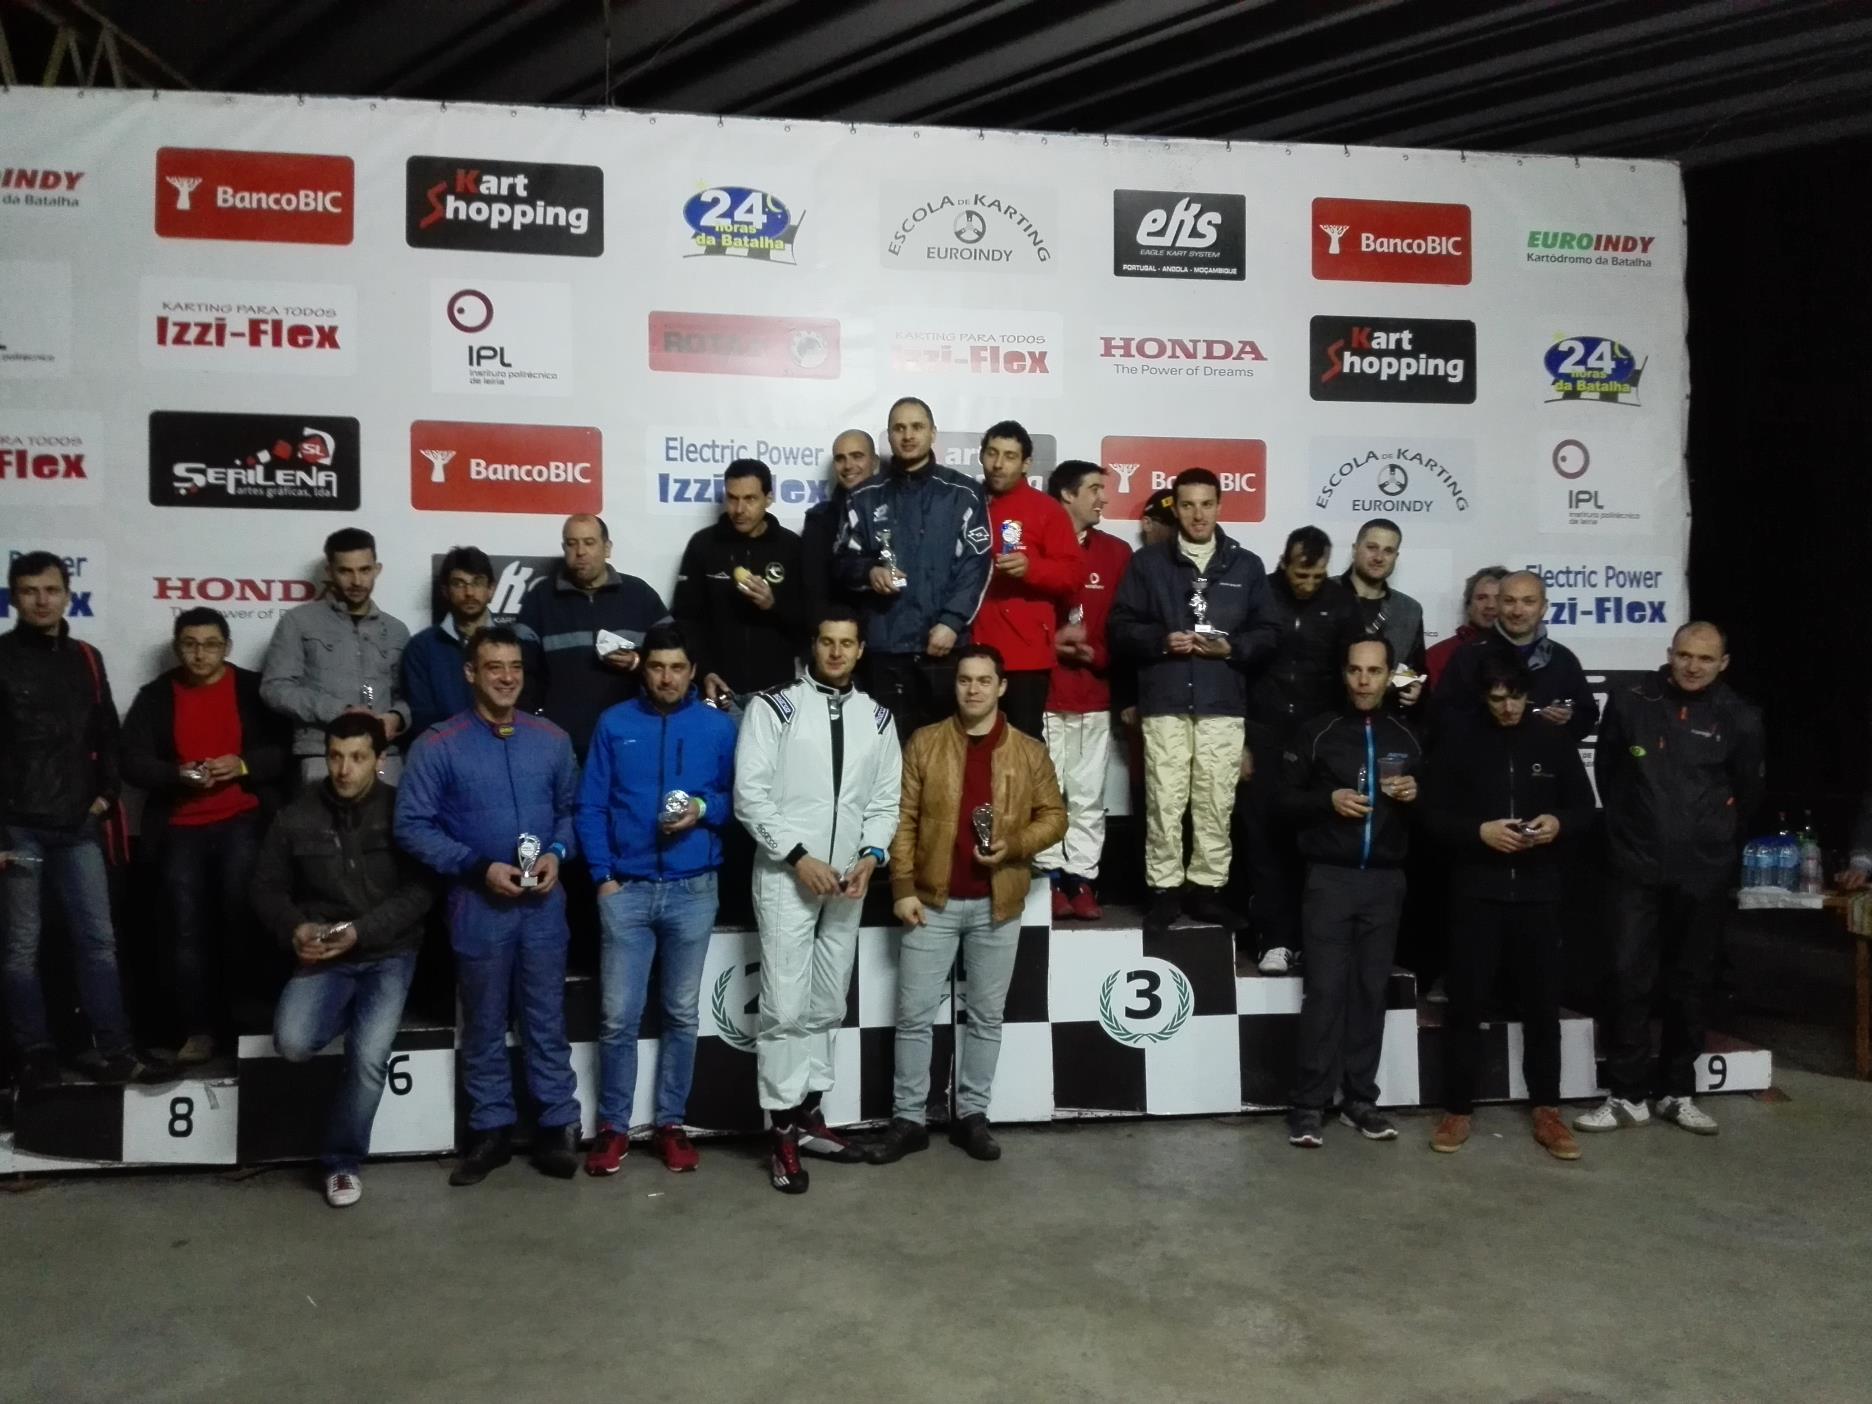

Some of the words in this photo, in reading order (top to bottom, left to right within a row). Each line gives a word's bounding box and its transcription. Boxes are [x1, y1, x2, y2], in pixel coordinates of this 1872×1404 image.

[455, 169, 528, 197] Kart
[217, 186, 342, 213] BancoBIC
[420, 181, 589, 234] Shopping
[700, 189, 767, 229] 24
[888, 195, 955, 257] ESCOLA
[973, 193, 1051, 262] KARTING
[696, 233, 716, 246] da
[721, 234, 785, 249] Batalha
[1361, 233, 1462, 256] BancoBIC
[1527, 231, 1655, 253] EUROINDY
[926, 246, 1013, 262] EUROINDY
[1595, 256, 1608, 265] da
[1611, 256, 1652, 267] Batalha
[1122, 264, 1157, 272] PORTUGAL
[1162, 265, 1189, 273] ANGOLA
[162, 302, 232, 313] KARTING
[236, 305, 279, 315] PARA
[285, 307, 337, 318] TODOS
[157, 316, 340, 349] Izzi-Flex
[960, 333, 996, 343] PARA
[999, 334, 1046, 344] TODOS
[1352, 327, 1413, 350] Kart
[468, 345, 512, 368] IPL
[892, 345, 1049, 374] zi-Flex
[1100, 337, 1268, 361] HONDA
[1321, 339, 1464, 383] Shopping
[1558, 340, 1616, 374] 24
[1114, 364, 1138, 375] The
[1141, 365, 1182, 376] Power
[1186, 366, 1200, 376] of
[1203, 367, 1254, 377] Dreams
[1554, 379, 1573, 392] da
[1577, 380, 1632, 393] Batalha
[28, 436, 82, 447] TODOS
[665, 437, 749, 463] Electric
[757, 440, 824, 466] Power
[470, 458, 591, 483] BancoBIC
[1152, 471, 1256, 492] BBIC
[1315, 450, 1379, 510] ESCOLA
[1396, 448, 1470, 511] KARTING
[1352, 500, 1433, 512] EUROINDY
[1568, 490, 1604, 509] IPL
[1526, 564, 1598, 588] ectric
[1605, 566, 1662, 588] Power
[257, 609, 274, 619] of
[1542, 597, 1667, 625] zi-Flex
[1125, 970, 1162, 1020] 3
[388, 1054, 412, 1096] 6
[1708, 1055, 1727, 1090] 9
[168, 1096, 194, 1138] 8
